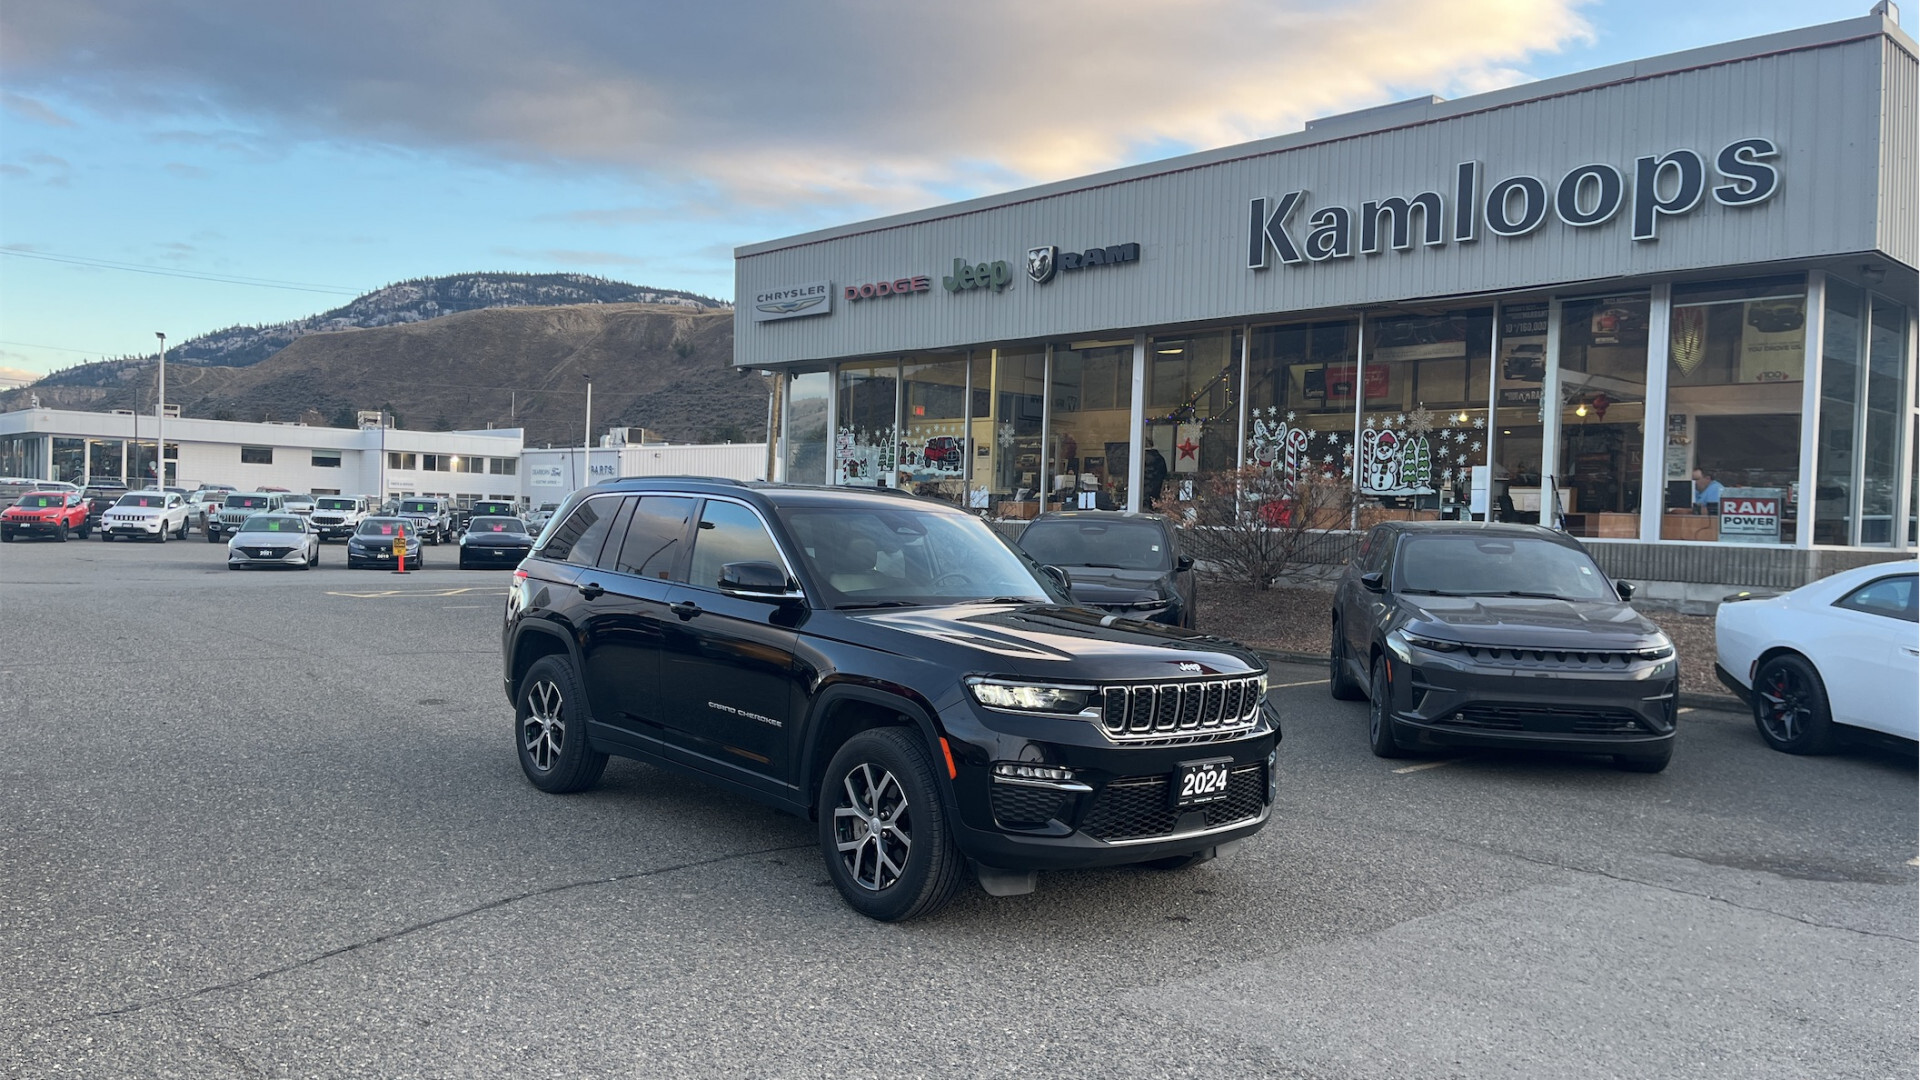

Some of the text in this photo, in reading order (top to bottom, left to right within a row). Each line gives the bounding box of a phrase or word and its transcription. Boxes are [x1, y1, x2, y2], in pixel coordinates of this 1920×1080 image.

[1247, 137, 1782, 271] Kamloops
[1058, 242, 1140, 271] RAM
[844, 275, 931, 302] DODGE
[943, 257, 1013, 293] Jeep
[756, 284, 826, 303] CHRYSLER
[1723, 501, 1775, 515] RAM
[1723, 516, 1775, 526] POWER
[1179, 662, 1202, 672] Jeep
[708, 701, 783, 728] GRAND CHEROKEE
[1181, 769, 1228, 796] 2024
